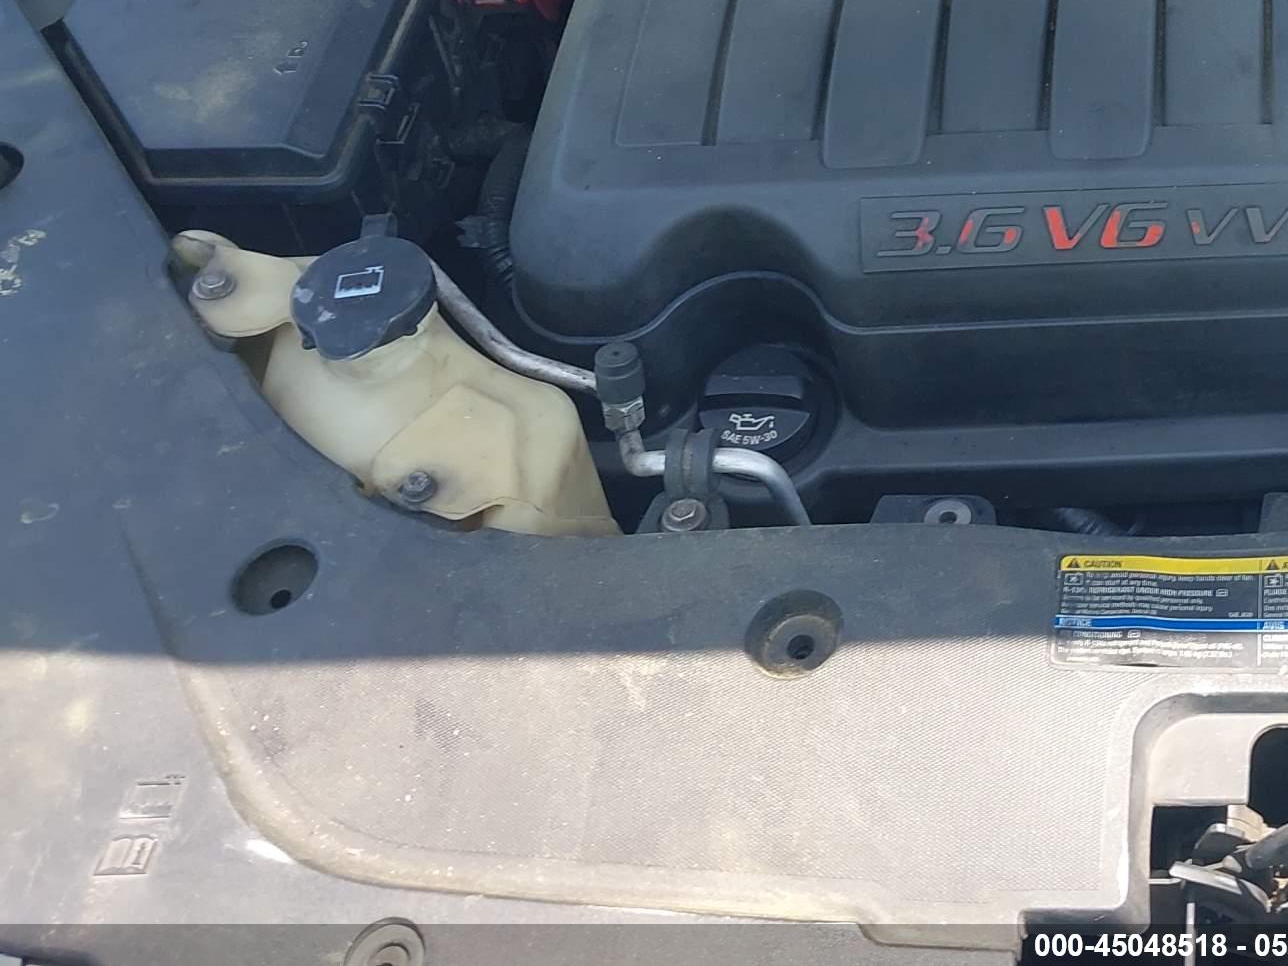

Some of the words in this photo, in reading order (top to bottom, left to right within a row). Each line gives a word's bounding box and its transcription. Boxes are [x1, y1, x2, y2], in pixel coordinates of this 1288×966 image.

[876, 206, 1024, 257] 3.6
[1044, 202, 1168, 250] V6
[720, 429, 742, 444] SAE
[742, 430, 778, 445] 5W-30
[1084, 560, 1122, 568] CAUTION
